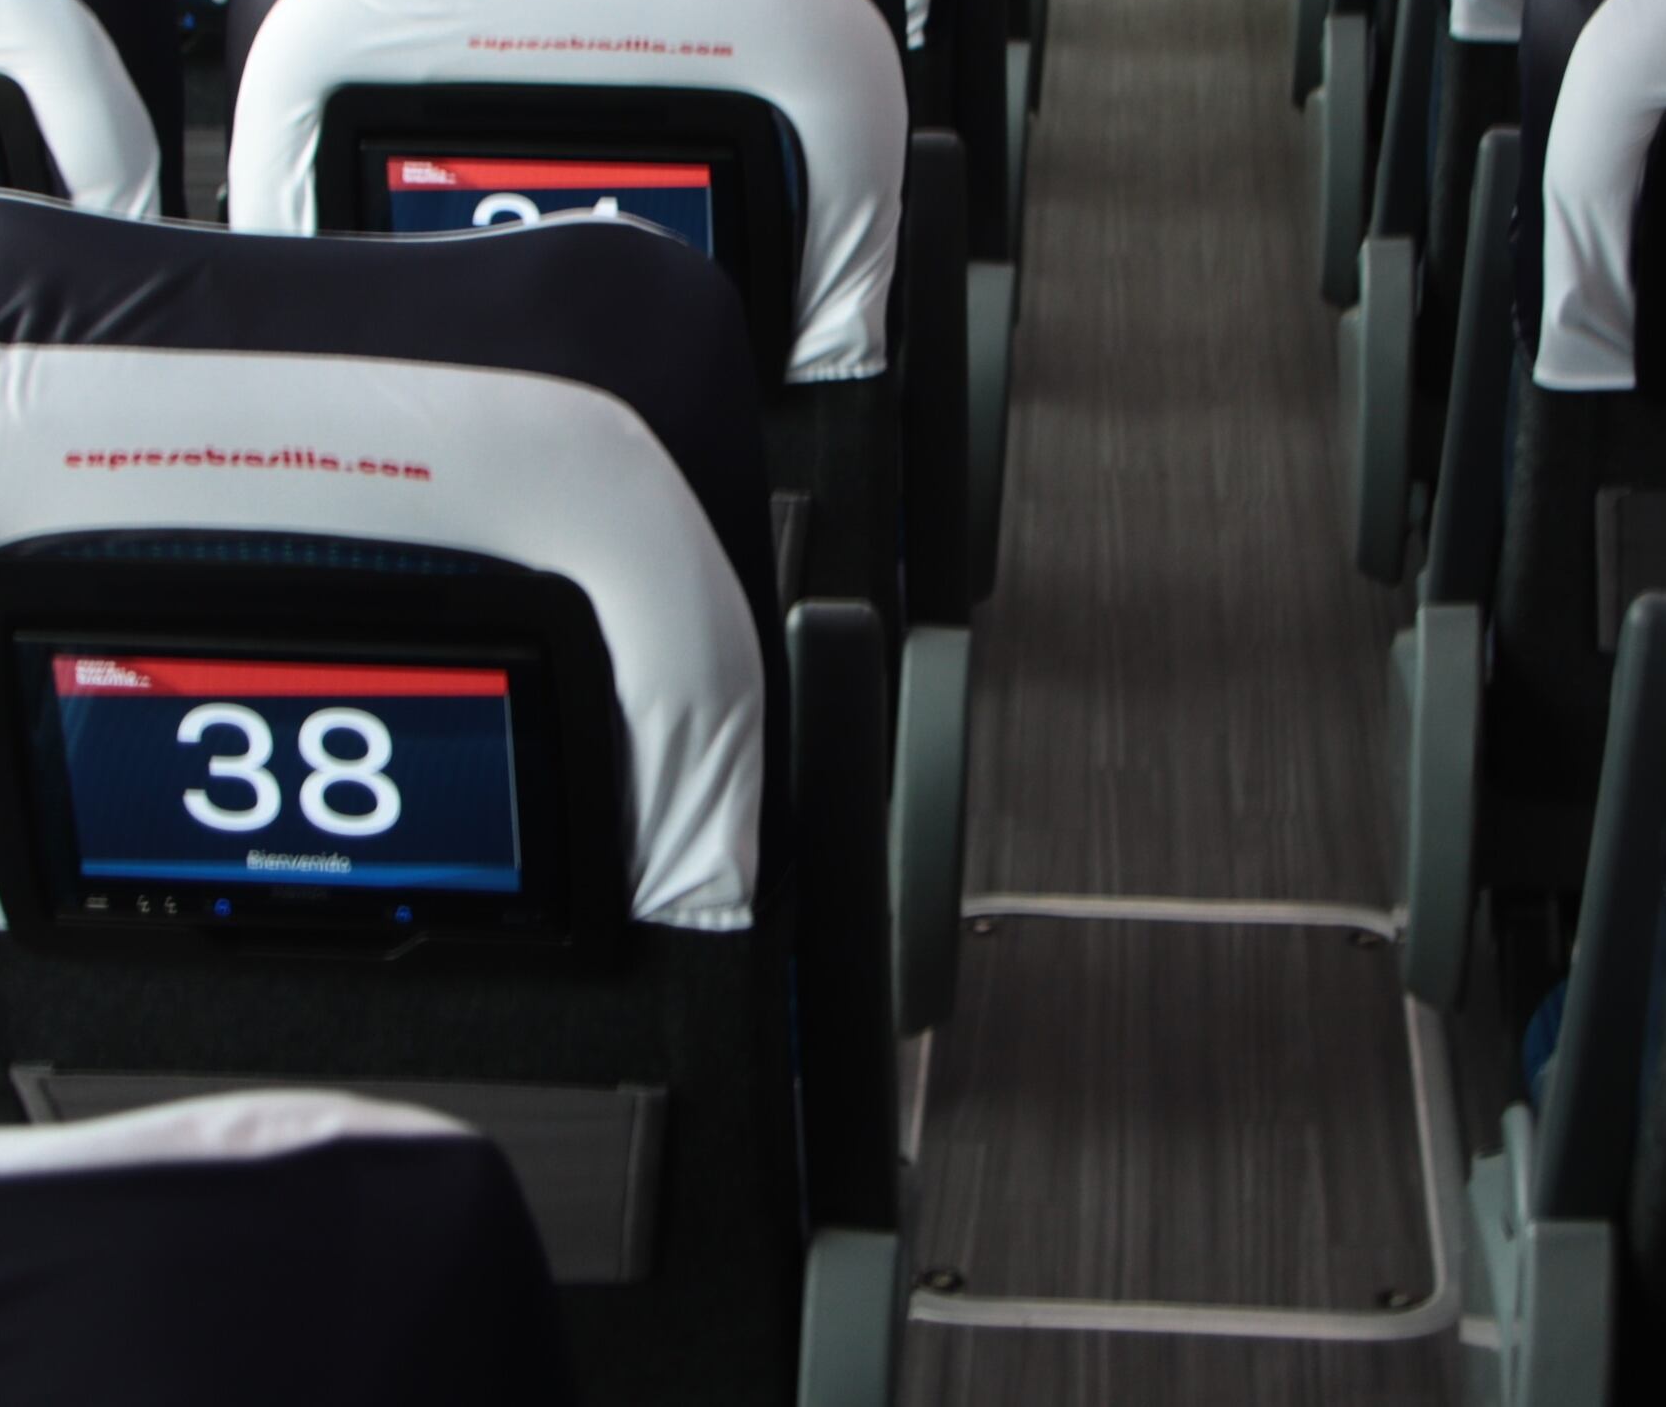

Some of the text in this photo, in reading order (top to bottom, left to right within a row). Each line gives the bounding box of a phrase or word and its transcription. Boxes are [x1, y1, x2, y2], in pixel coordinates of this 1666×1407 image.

[63, 447, 433, 483] expresobrasilia.com
[177, 703, 401, 836] 38
[247, 849, 351, 873] Bienvenido
